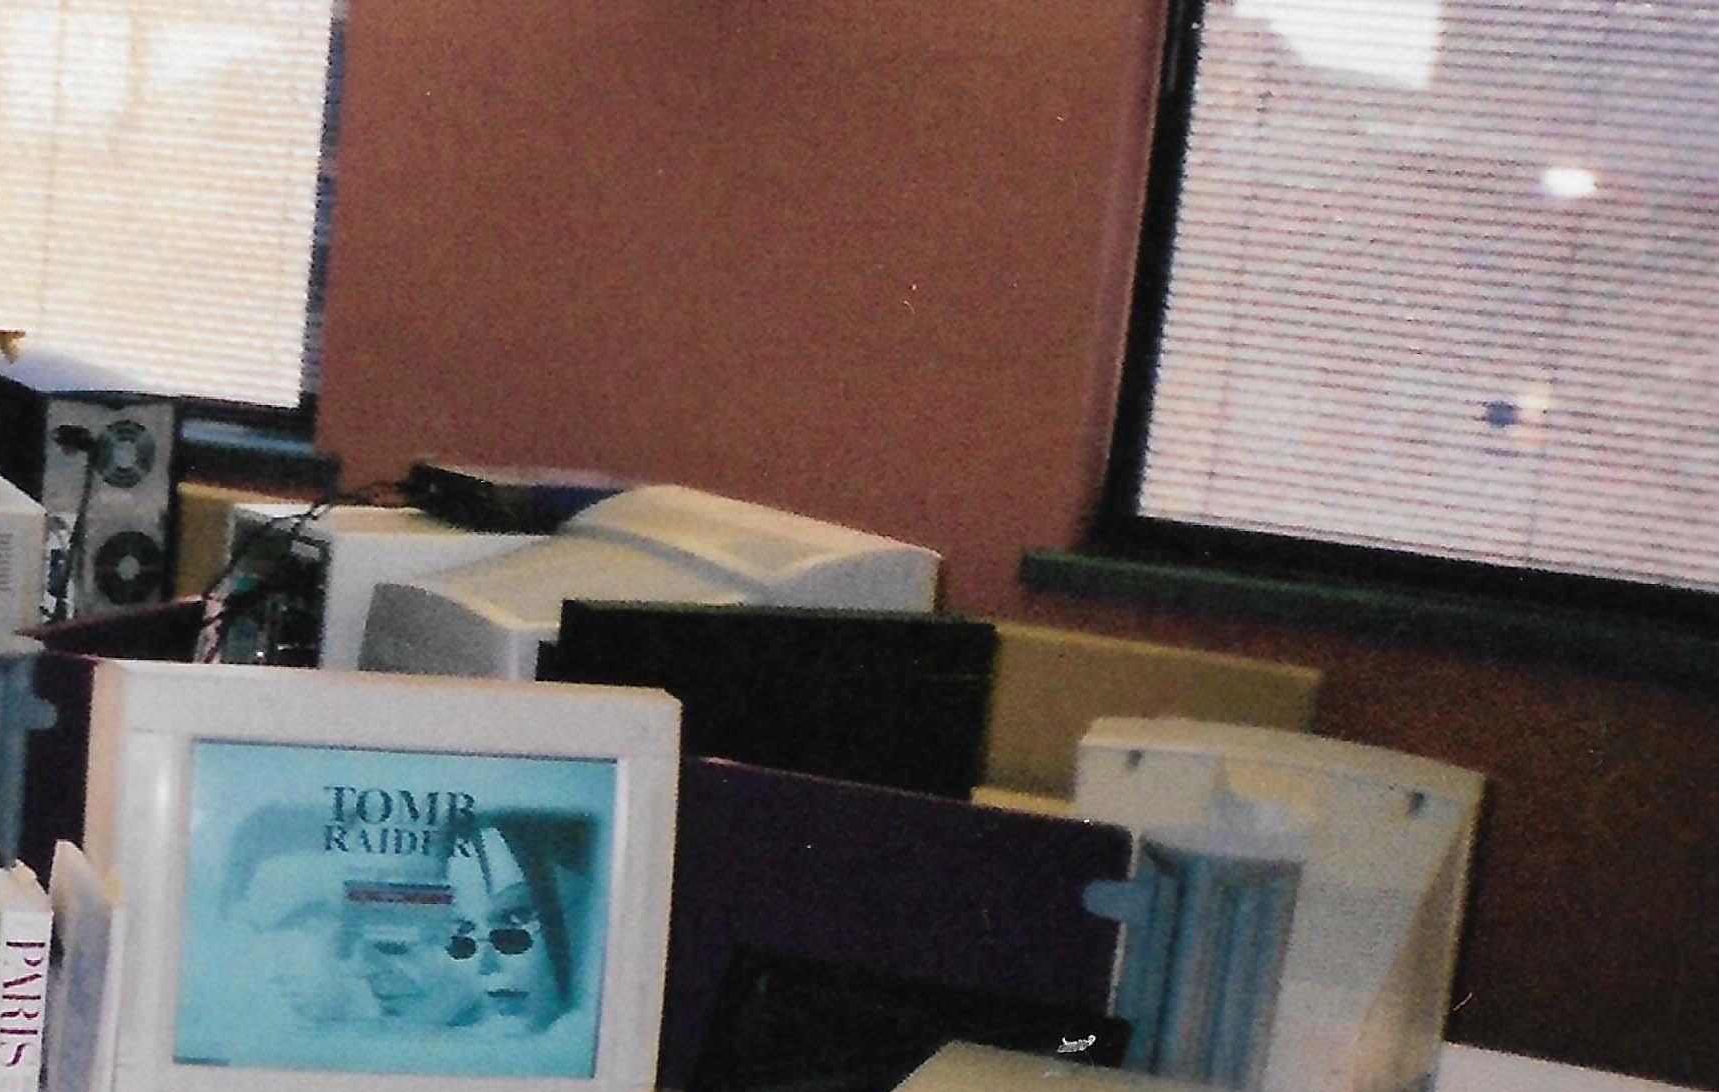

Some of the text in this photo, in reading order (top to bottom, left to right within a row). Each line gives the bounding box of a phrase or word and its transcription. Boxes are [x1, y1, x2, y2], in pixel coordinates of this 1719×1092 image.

[323, 785, 476, 827] TOMB
[324, 824, 473, 858] RAIDER
[0, 941, 45, 1067] PARIS
